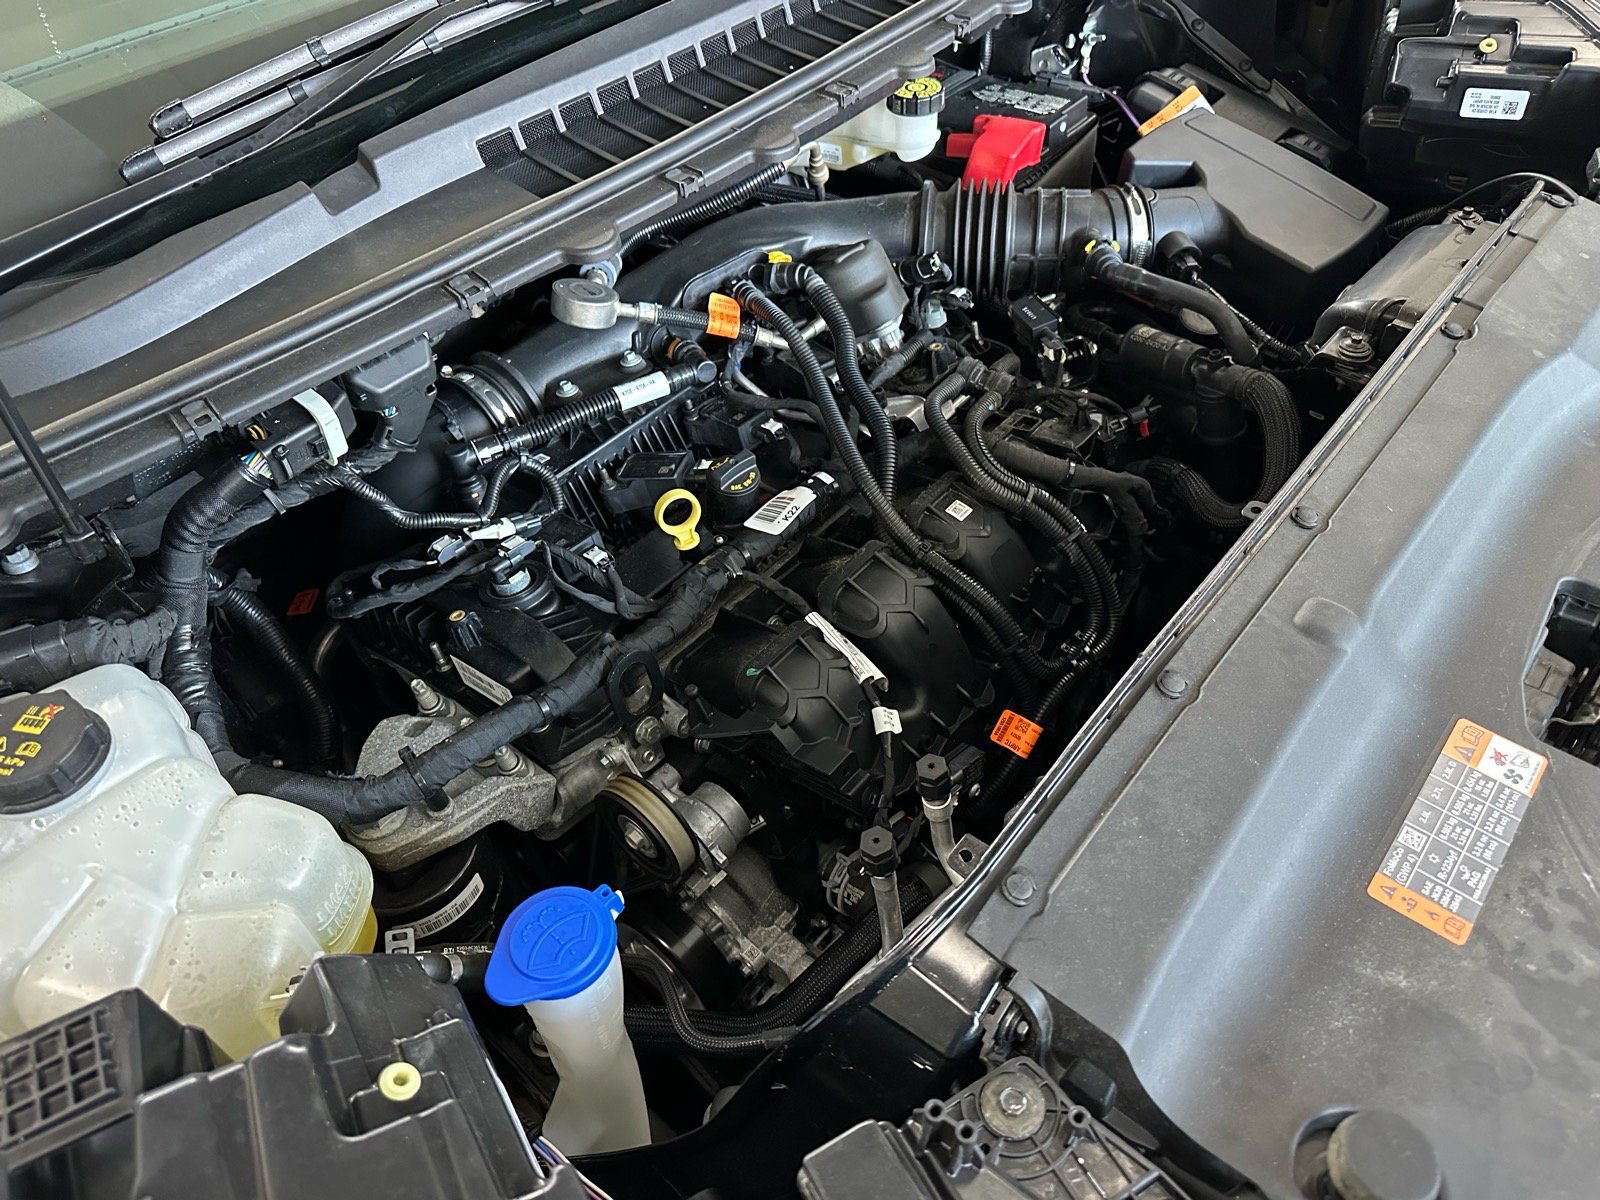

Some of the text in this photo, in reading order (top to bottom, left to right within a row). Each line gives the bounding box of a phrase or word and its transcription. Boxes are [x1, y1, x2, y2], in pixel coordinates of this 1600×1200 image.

[782, 505, 801, 522] K22
[4, 757, 25, 767] kPa
[1430, 784, 1444, 800] 2.7L
[1382, 845, 1404, 876] FoMoCo
[1394, 852, 1418, 885] (GWP 4)
[1466, 869, 1481, 888] PAG
